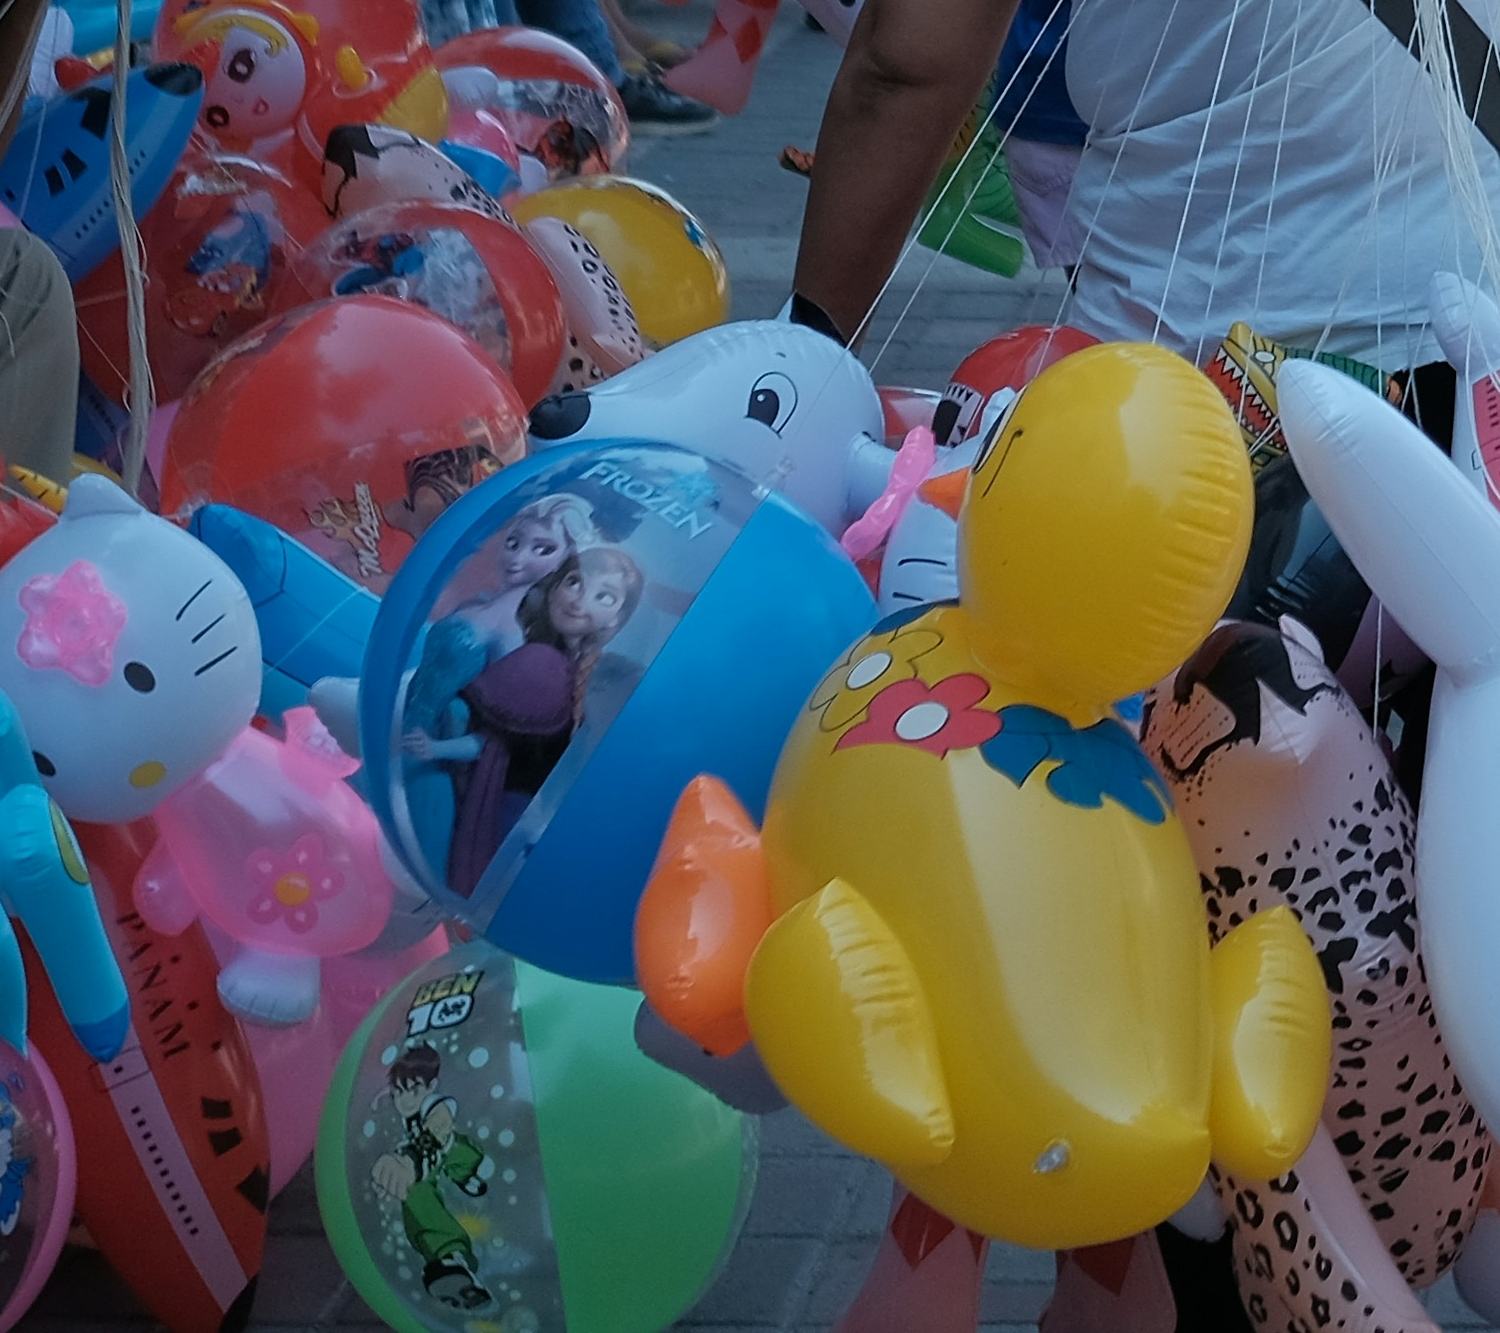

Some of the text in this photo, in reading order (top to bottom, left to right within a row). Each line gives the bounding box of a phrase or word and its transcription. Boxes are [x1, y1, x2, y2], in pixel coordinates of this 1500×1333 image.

[581, 461, 713, 542] FROZEN
[411, 970, 485, 1008] BEN
[406, 992, 475, 1038] 10
